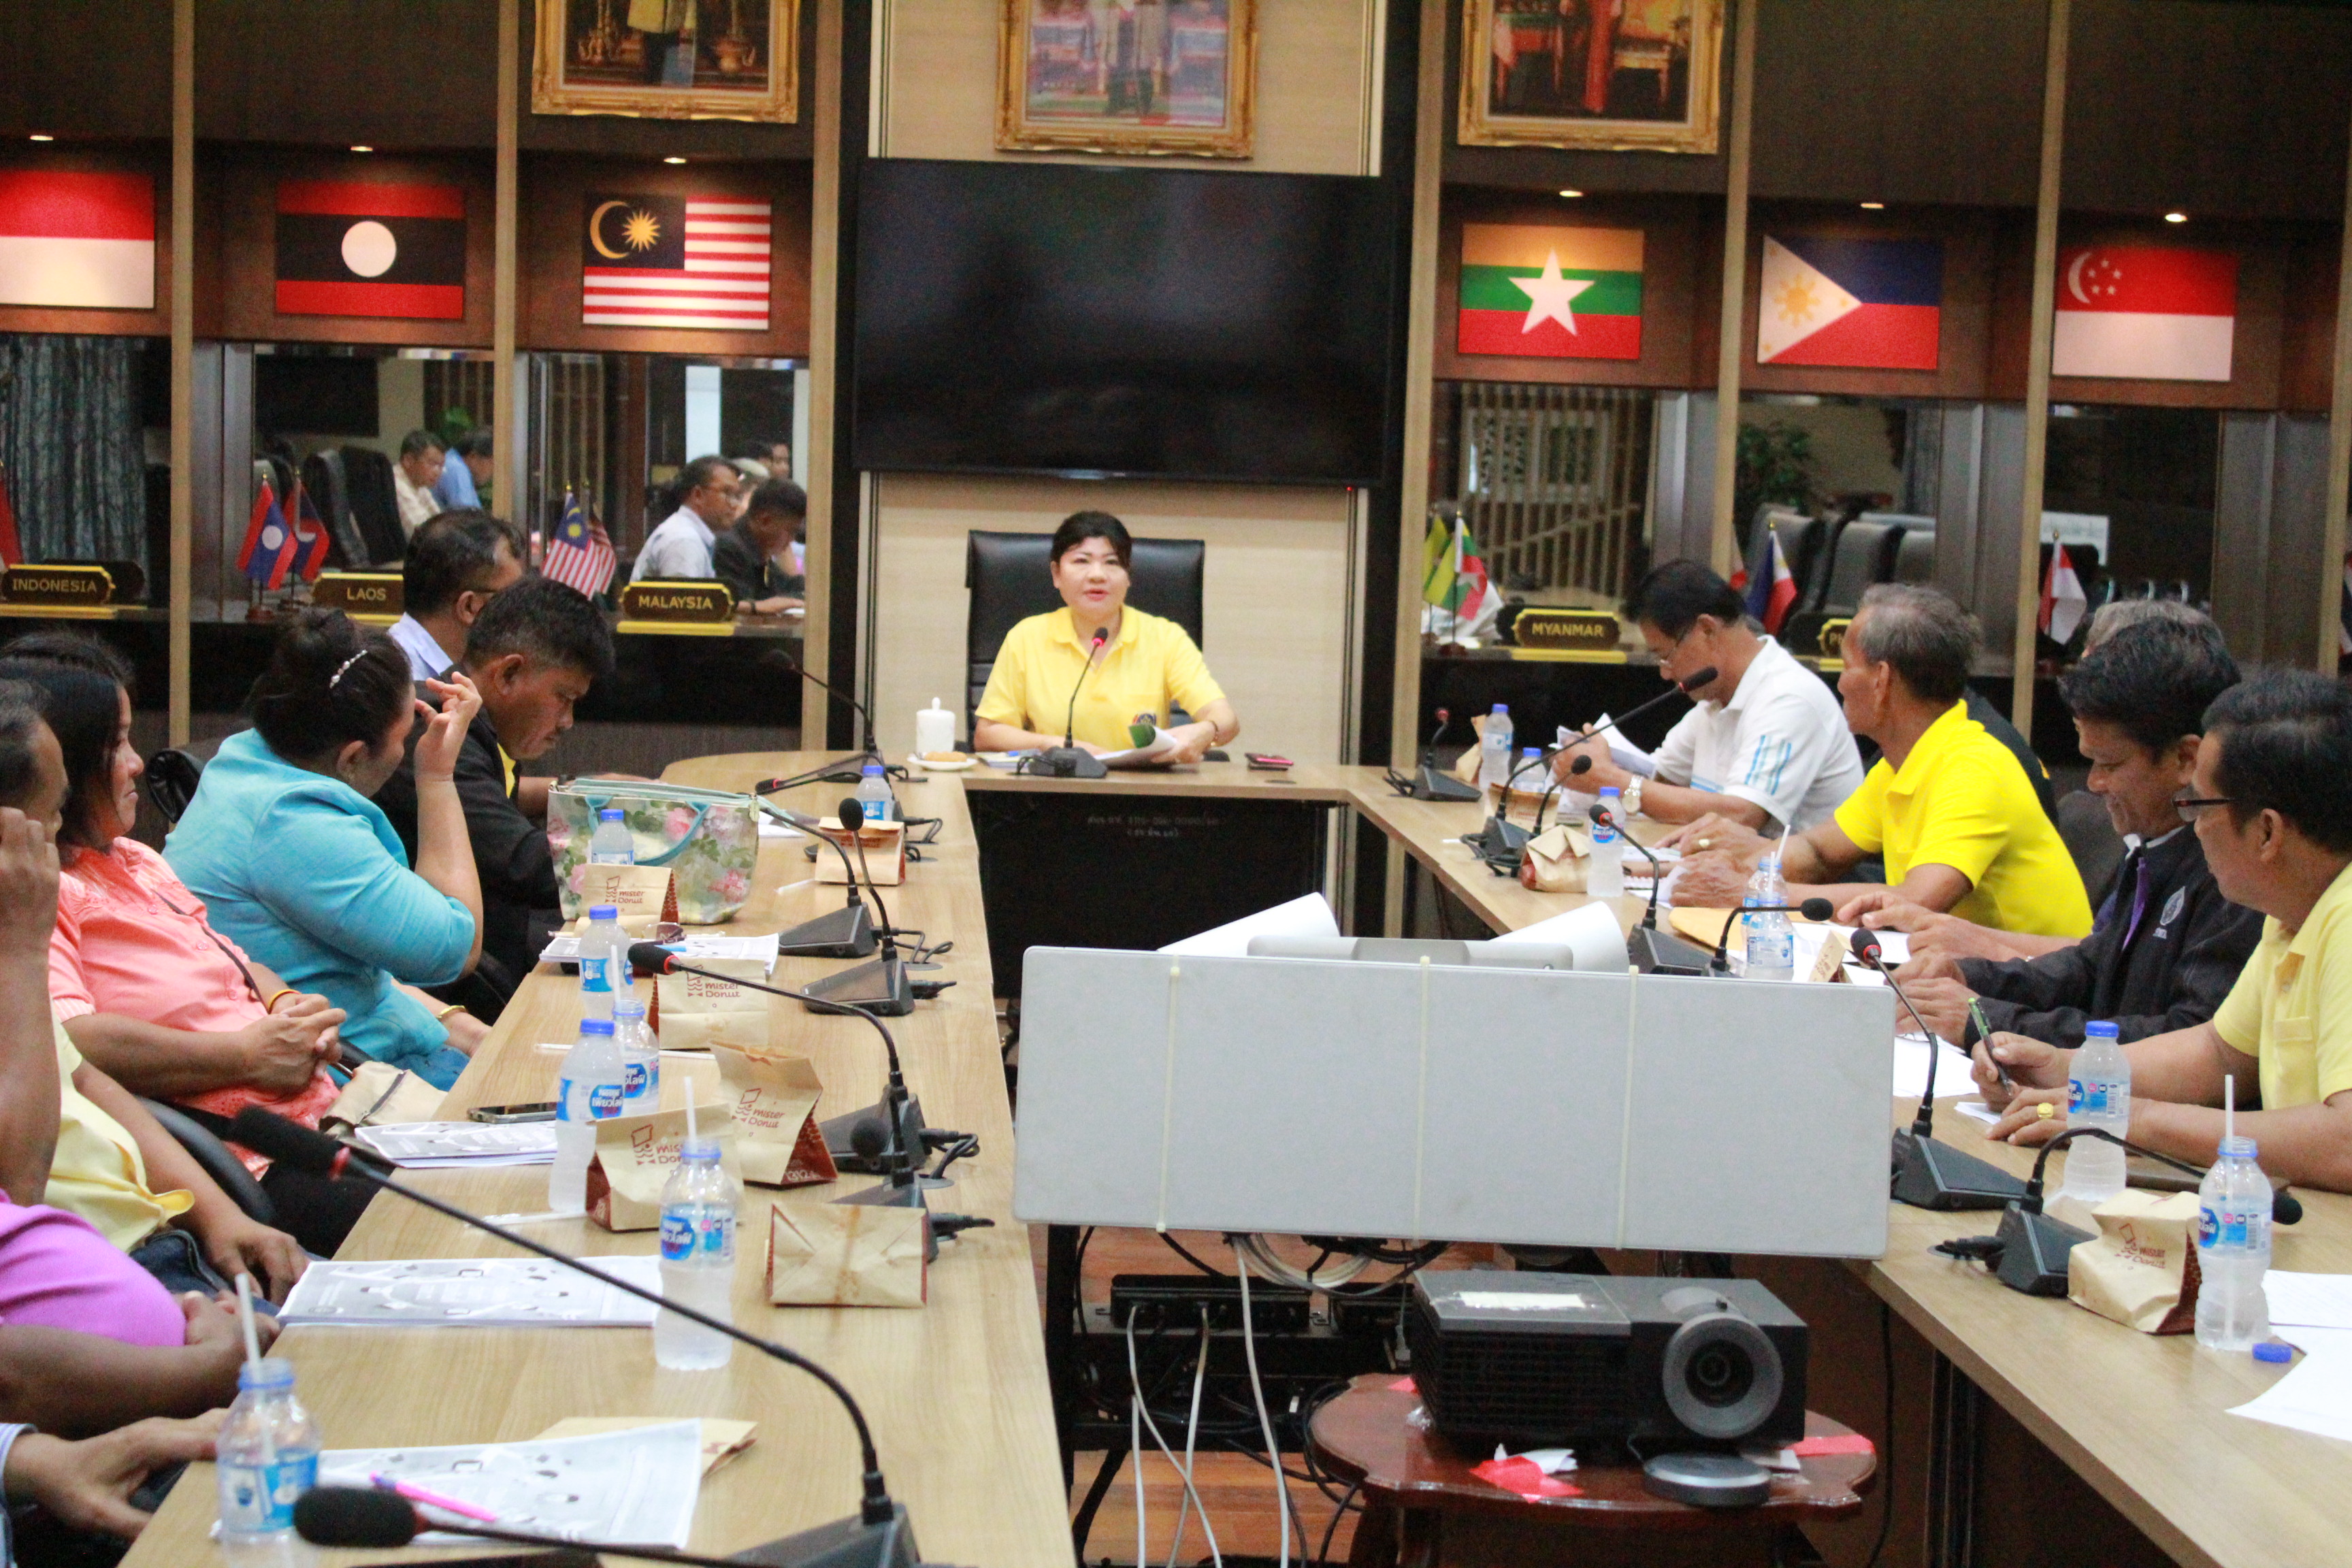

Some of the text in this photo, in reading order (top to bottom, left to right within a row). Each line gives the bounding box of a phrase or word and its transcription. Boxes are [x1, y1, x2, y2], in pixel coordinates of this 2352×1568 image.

[12, 578, 97, 593] INDONESIA
[346, 587, 387, 601] LAOS
[638, 595, 713, 610] MALAYSIA
[1532, 622, 1604, 637] MYANMAR
[753, 1108, 785, 1120] mister
[748, 1117, 780, 1128] Donut
